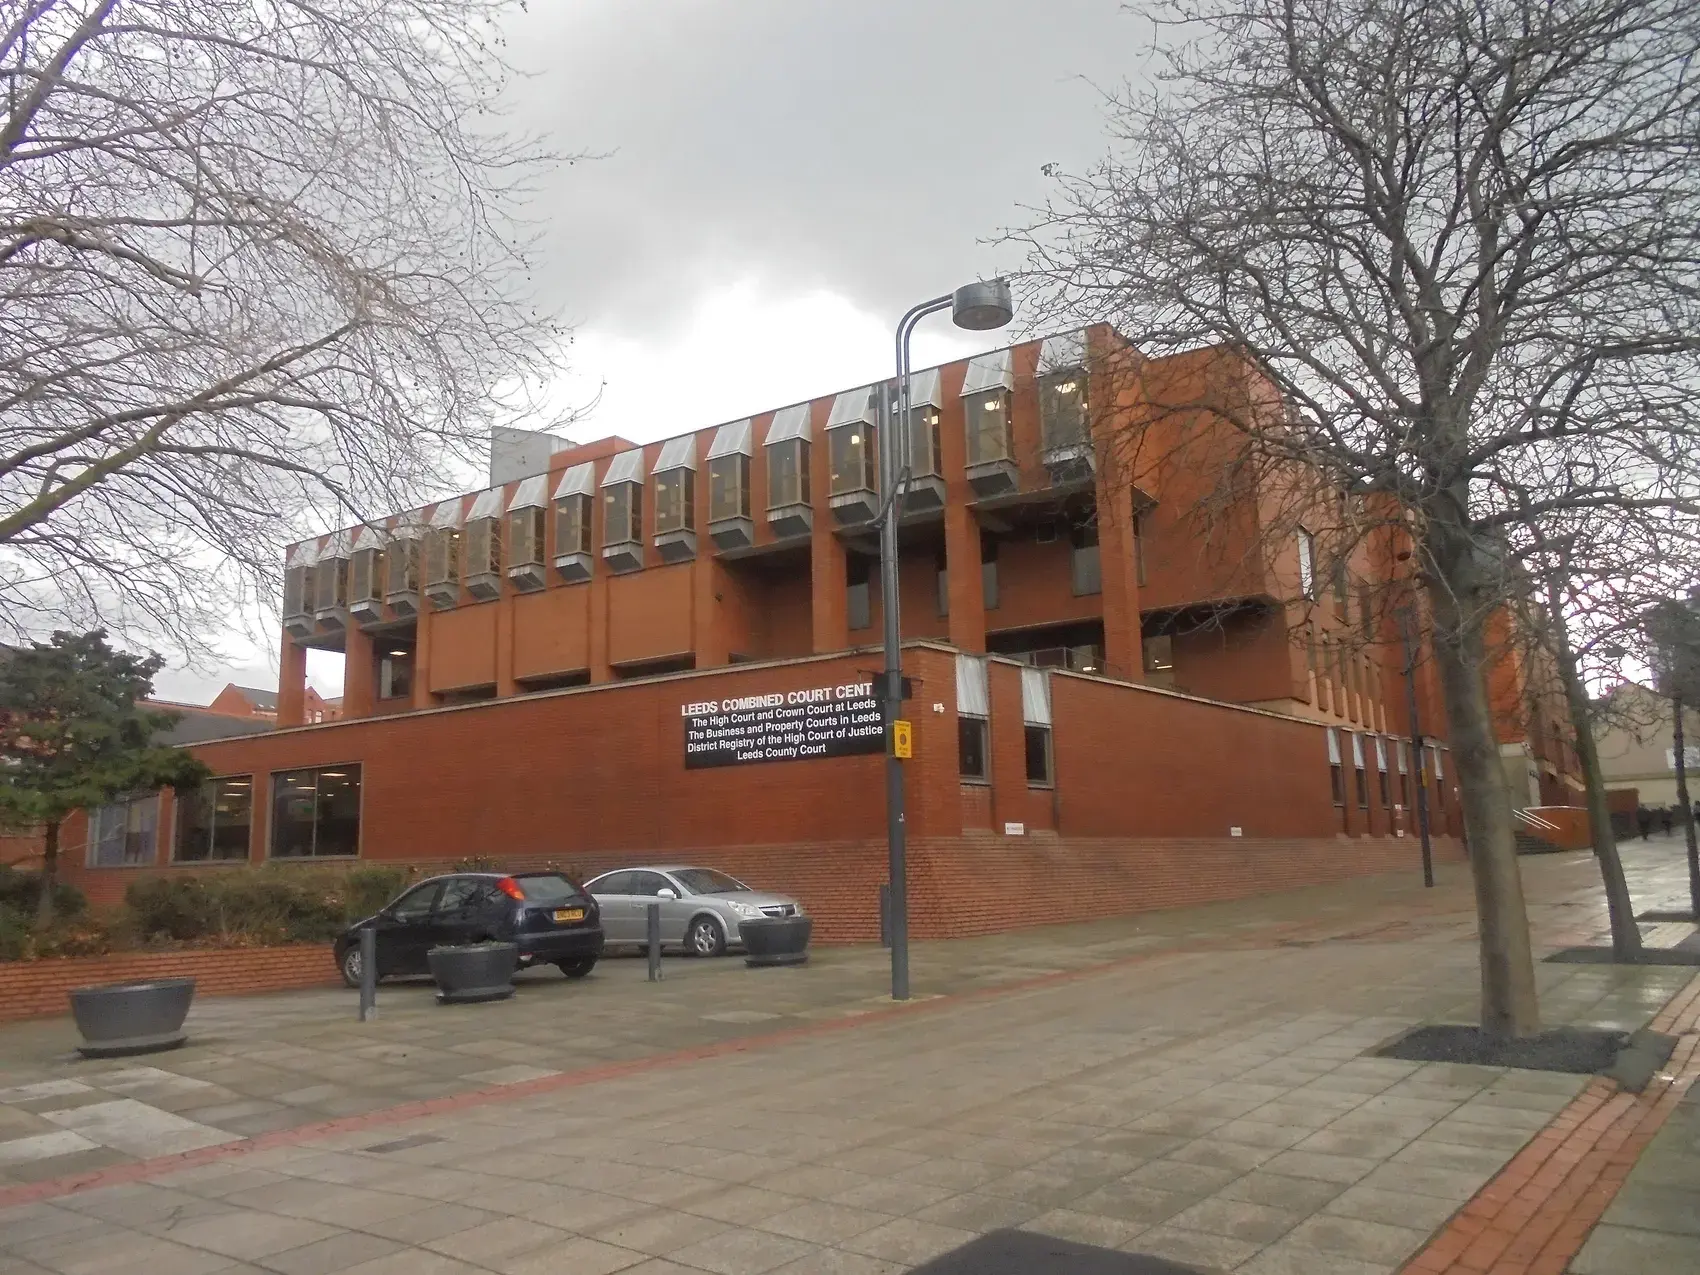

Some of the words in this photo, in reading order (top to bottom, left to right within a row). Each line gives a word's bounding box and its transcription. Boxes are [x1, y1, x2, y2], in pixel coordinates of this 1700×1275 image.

[681, 701, 718, 716] LEEDS
[722, 693, 784, 711] COMBINED
[787, 687, 833, 705] COURT
[835, 682, 873, 699] CENT
[692, 718, 708, 727] The
[709, 714, 729, 727] High
[731, 711, 755, 724] Court
[757, 709, 774, 720] and
[775, 705, 805, 718] Crown
[806, 702, 833, 715] Court
[835, 701, 845, 712] at
[846, 698, 877, 711] Leeds
[687, 742, 718, 753] District
[719, 738, 755, 750] Registry
[757, 735, 767, 746] of
[767, 734, 782, 744] the
[784, 732, 806, 745] High
[807, 728, 834, 741] Court
[836, 726, 846, 738] of
[848, 724, 883, 738] Justice
[689, 731, 705, 740] The
[706, 726, 745, 739] Business
[746, 723, 764, 734] and
[765, 718, 804, 733] Property
[806, 715, 838, 728] Courts
[840, 714, 849, 725] in
[851, 711, 881, 724] Leeds
[737, 749, 764, 760] Leeds
[765, 745, 798, 758] County
[799, 743, 827, 755] Court
